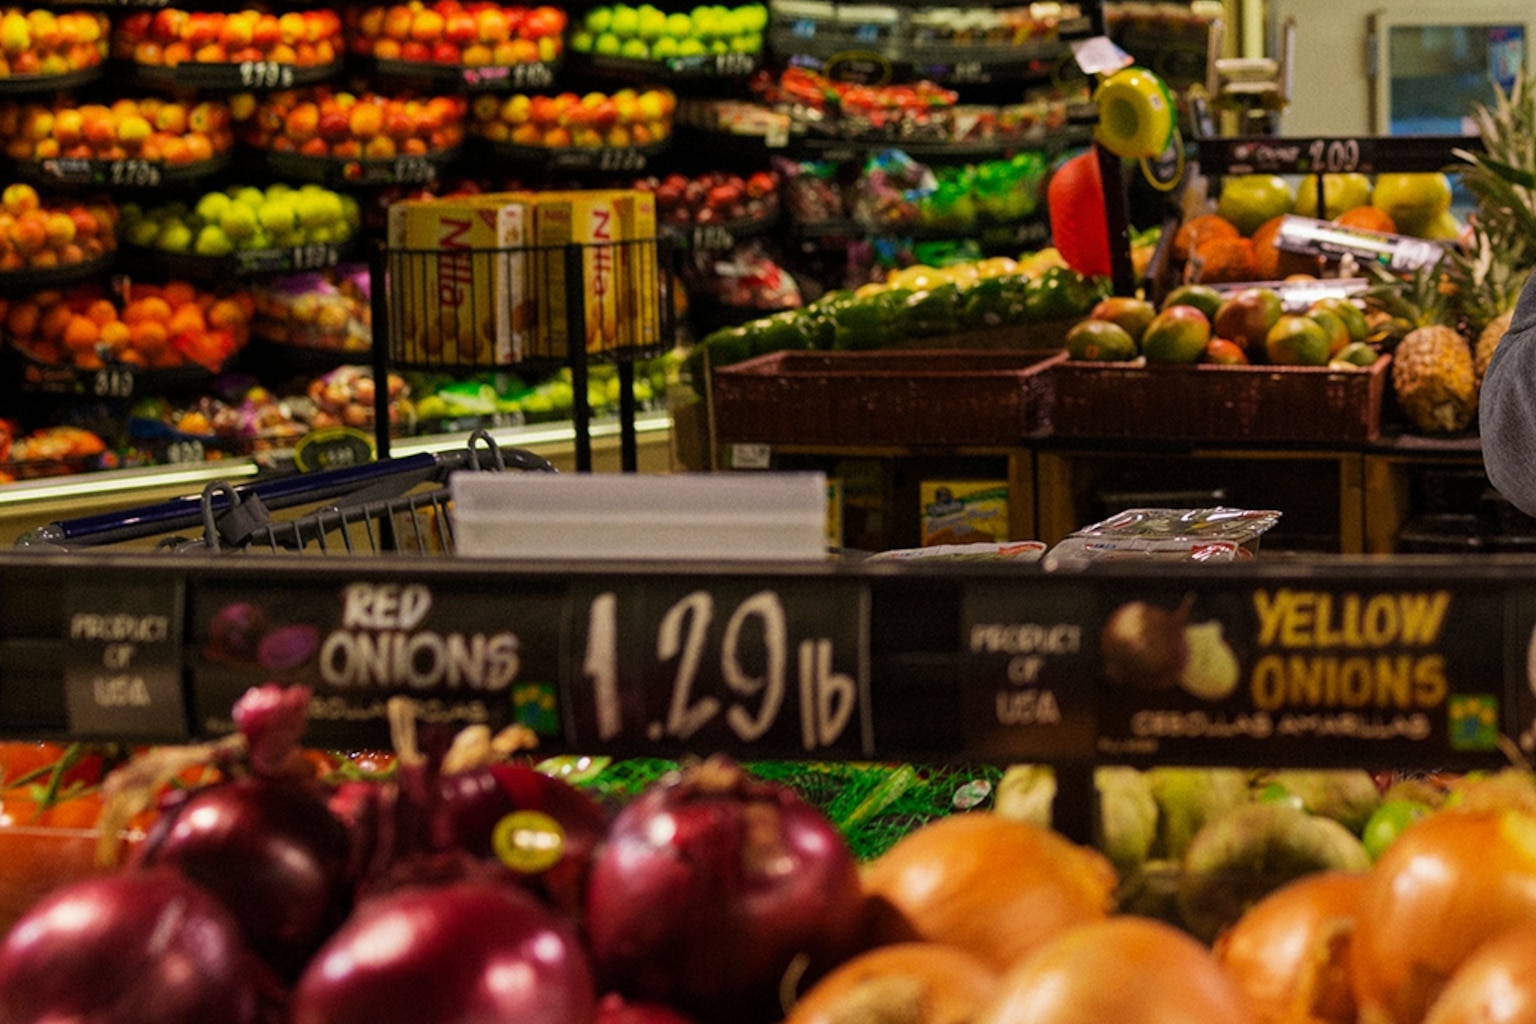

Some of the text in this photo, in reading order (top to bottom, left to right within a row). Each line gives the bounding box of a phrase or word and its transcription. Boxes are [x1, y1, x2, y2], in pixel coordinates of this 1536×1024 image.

[342, 583, 433, 629] RED
[1252, 588, 1451, 647] YELLOW
[319, 629, 521, 691] ONIONS
[582, 590, 857, 751] 1.29 lb
[1252, 655, 1449, 710] ONIONS
